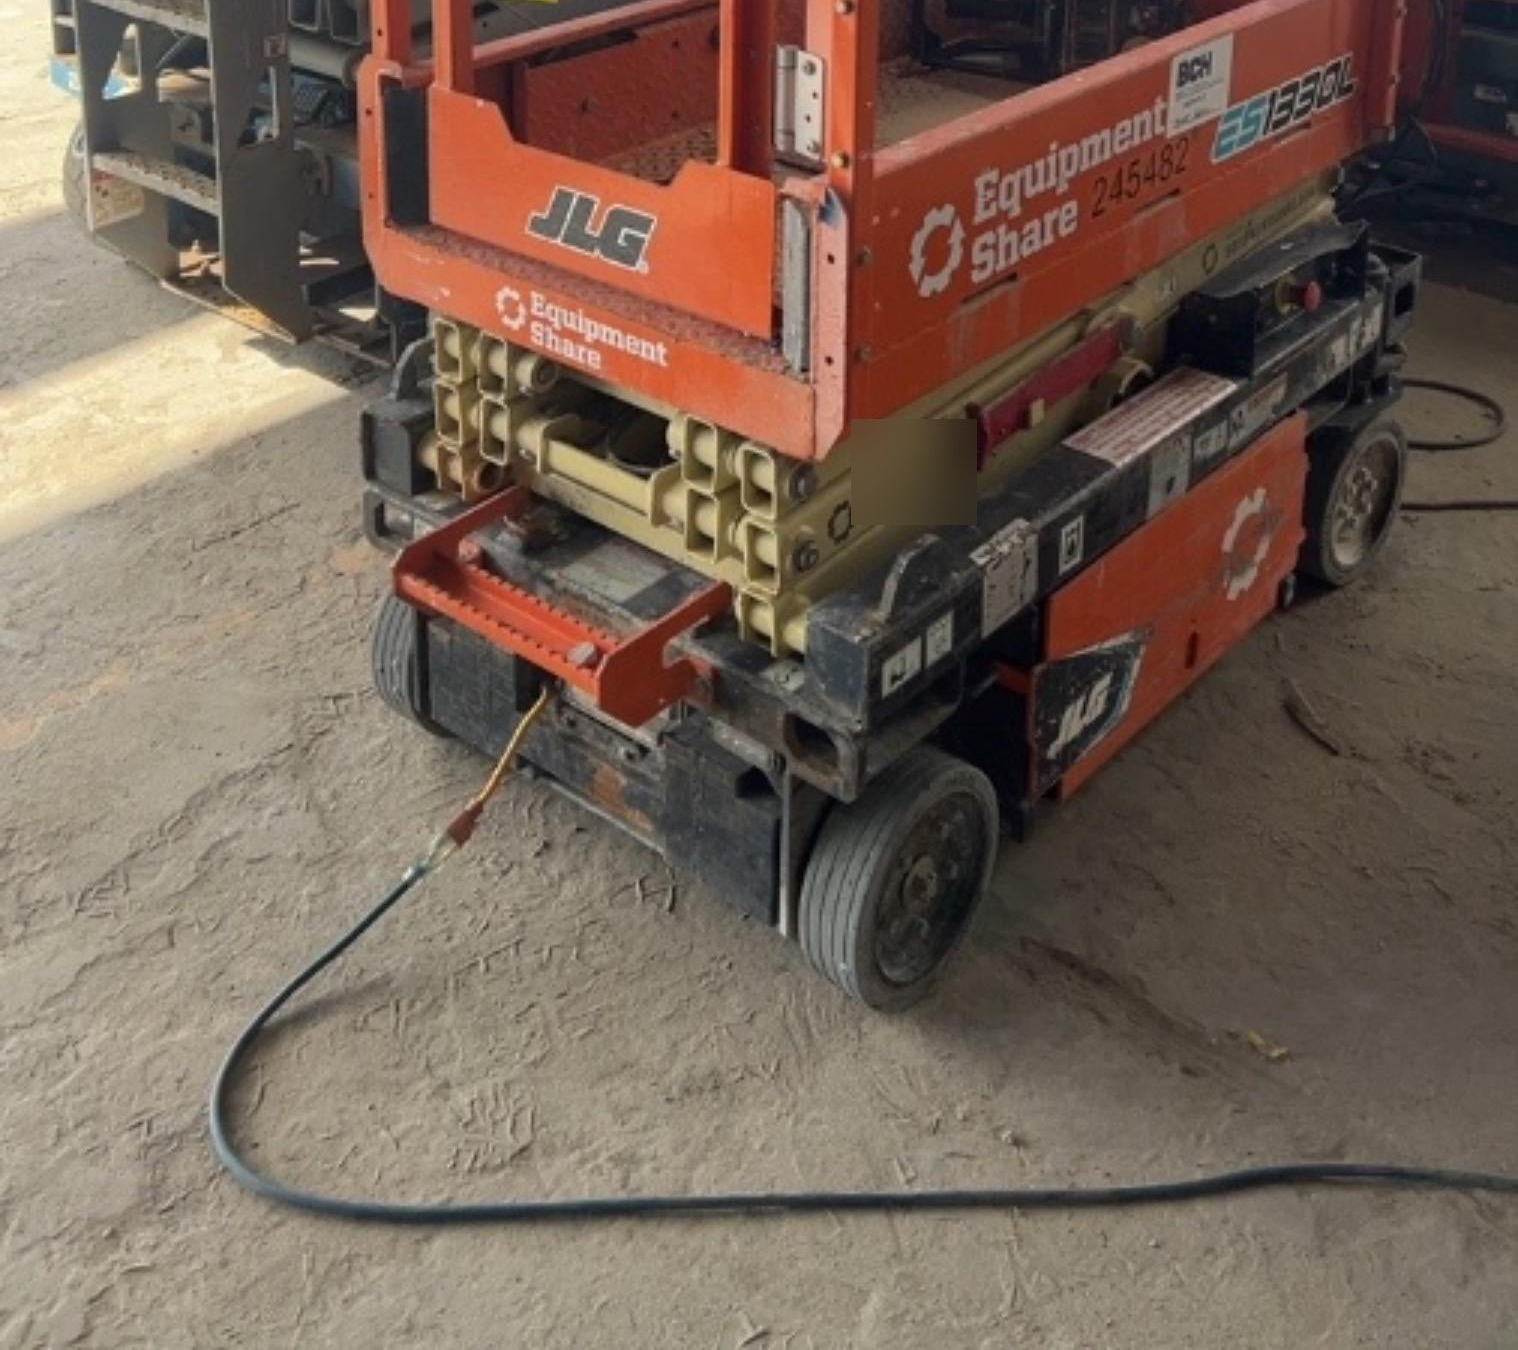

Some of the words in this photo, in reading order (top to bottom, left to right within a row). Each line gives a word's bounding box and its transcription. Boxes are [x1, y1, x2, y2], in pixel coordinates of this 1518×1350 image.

[974, 95, 1168, 224] Equipment
[1091, 136, 1189, 218] 245482
[525, 186, 657, 271] JLG
[970, 200, 1079, 284] Share
[530, 290, 668, 367] Equipment
[530, 320, 601, 370] Share
[1046, 671, 1113, 760] JLG
